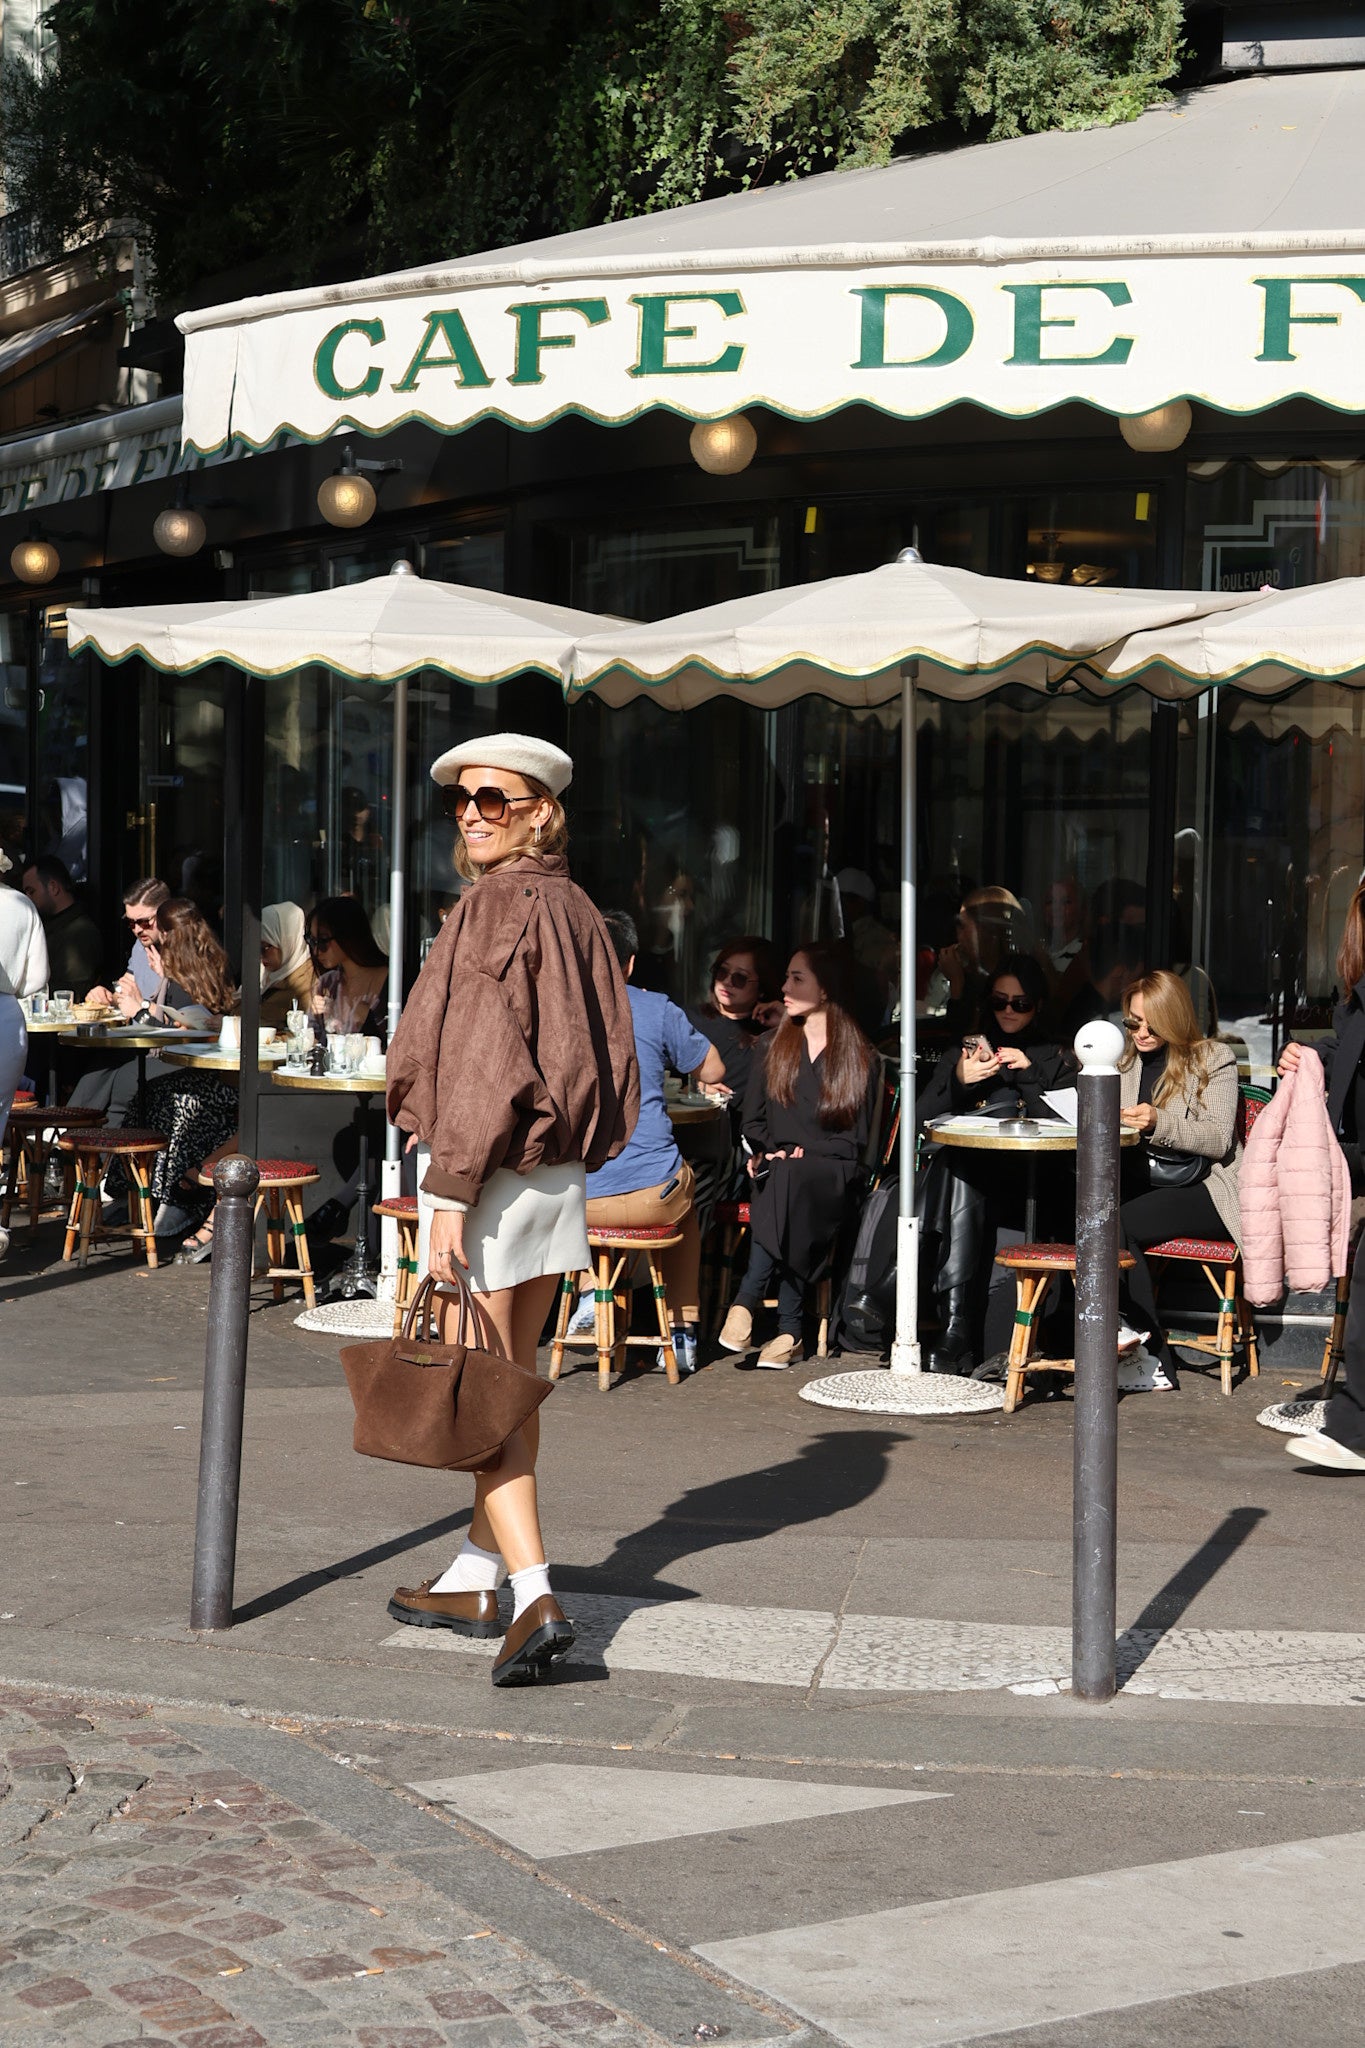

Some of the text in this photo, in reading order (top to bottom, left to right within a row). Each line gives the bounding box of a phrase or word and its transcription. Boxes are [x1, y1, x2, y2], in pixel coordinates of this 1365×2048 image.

[313, 274, 1365, 400] CAFE DE F
